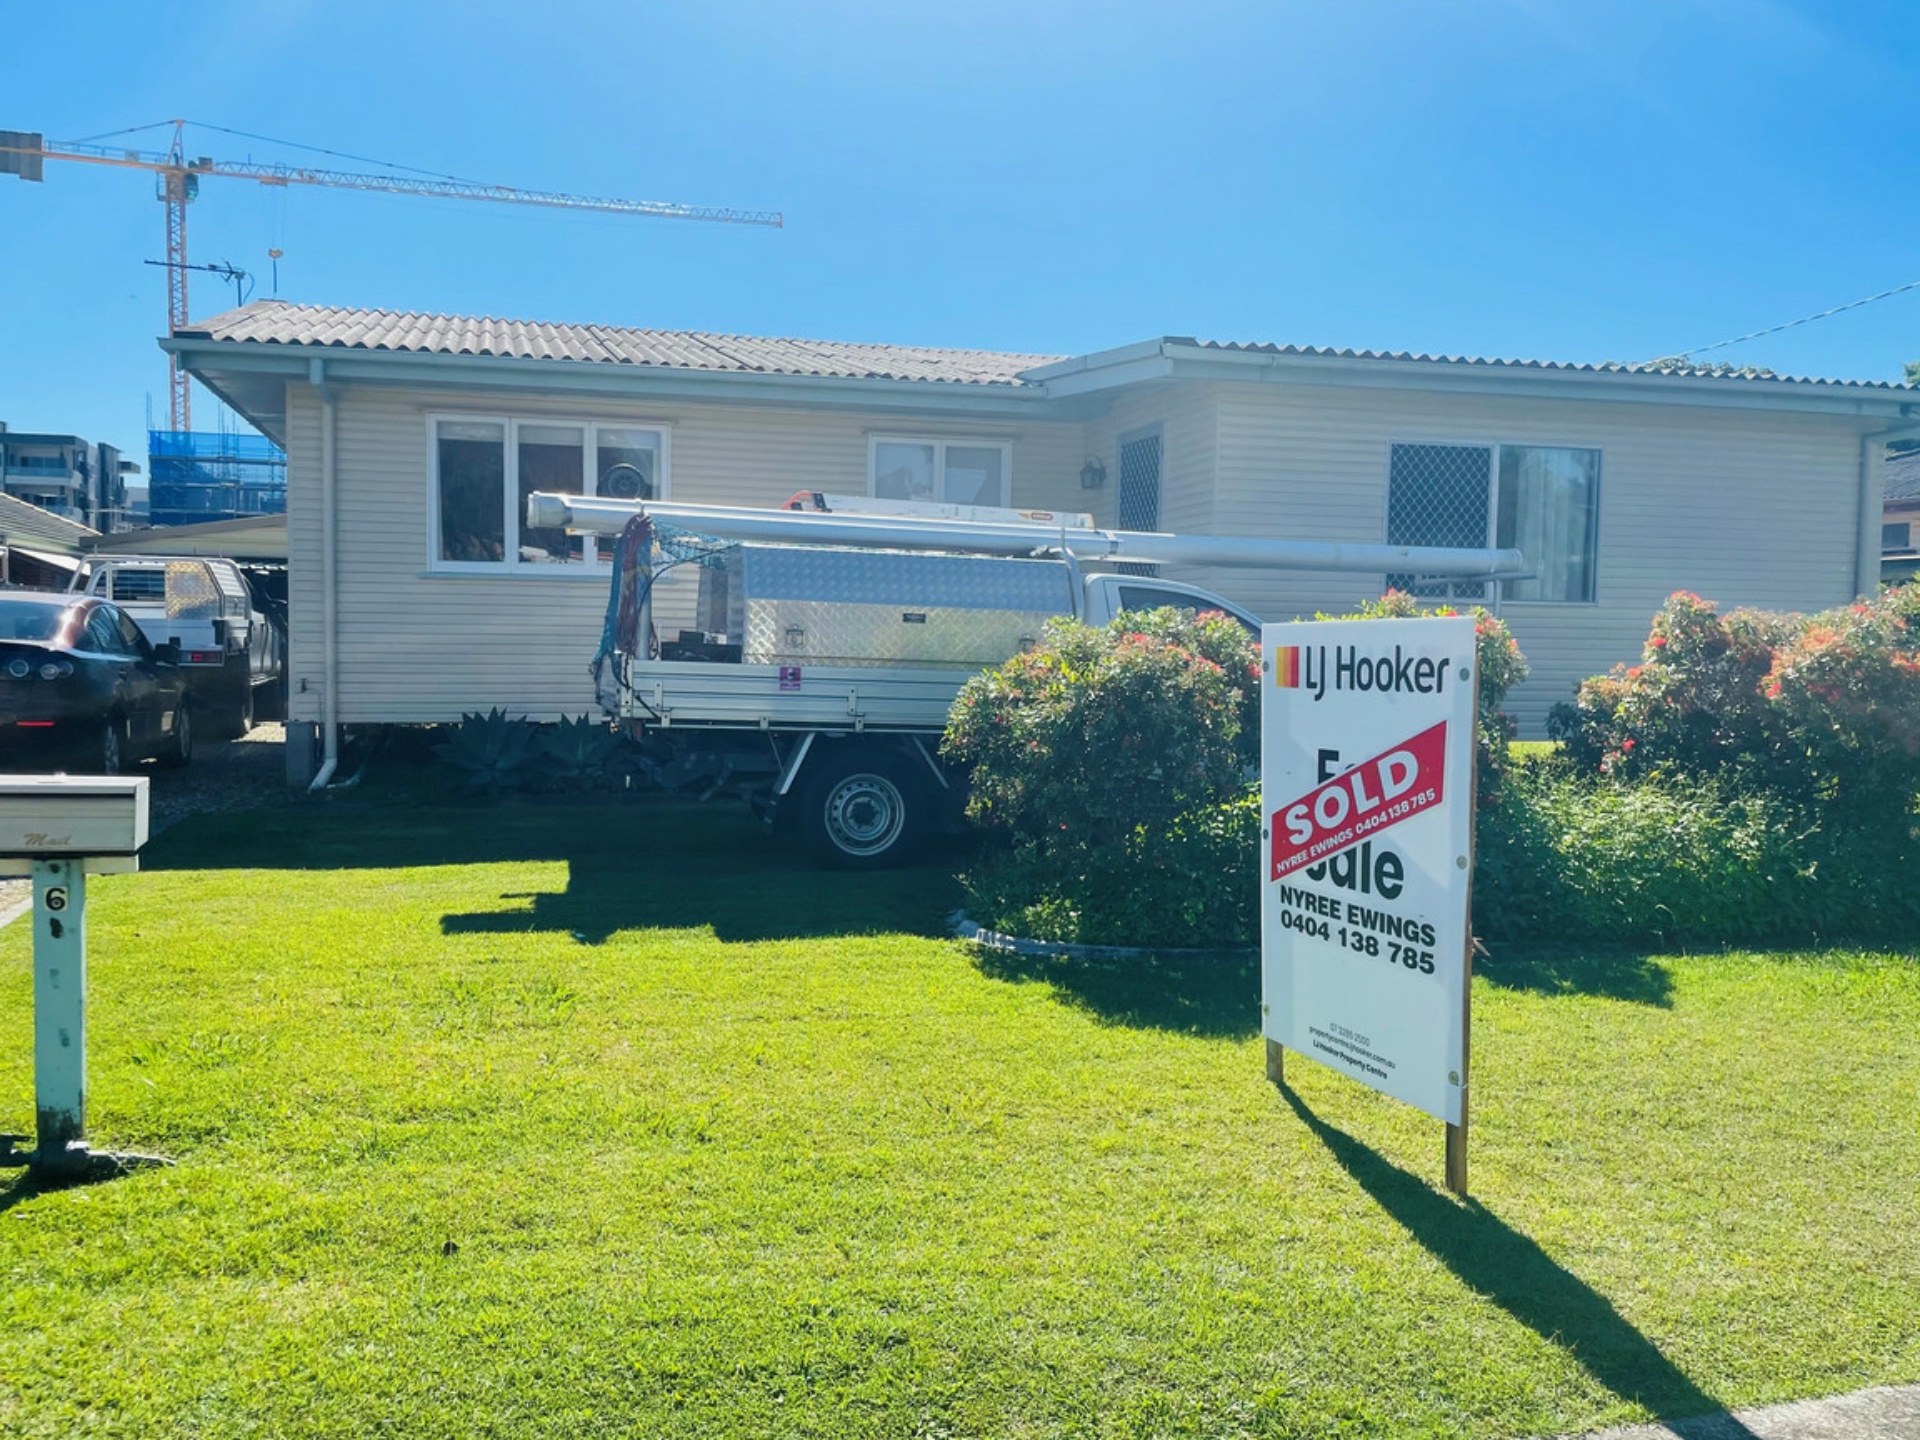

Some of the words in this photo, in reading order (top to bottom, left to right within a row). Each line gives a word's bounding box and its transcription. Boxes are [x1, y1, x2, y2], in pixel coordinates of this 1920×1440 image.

[1306, 645, 1325, 701] LJ
[1336, 644, 1449, 693] Hooker
[1285, 750, 1418, 845] SOLD
[23, 832, 73, 846] Mail
[1276, 849, 1308, 873] NYREE
[1310, 828, 1353, 857] EWINGS
[1356, 812, 1387, 835] 0404
[1388, 801, 1409, 820] 138
[1410, 788, 1435, 809] 785
[45, 887, 66, 911] 6
[1280, 884, 1341, 920] NYREE
[1348, 903, 1436, 947] EWINGS
[1281, 909, 1330, 941] 0404
[1338, 927, 1379, 957] 138
[1388, 941, 1435, 975] 785
